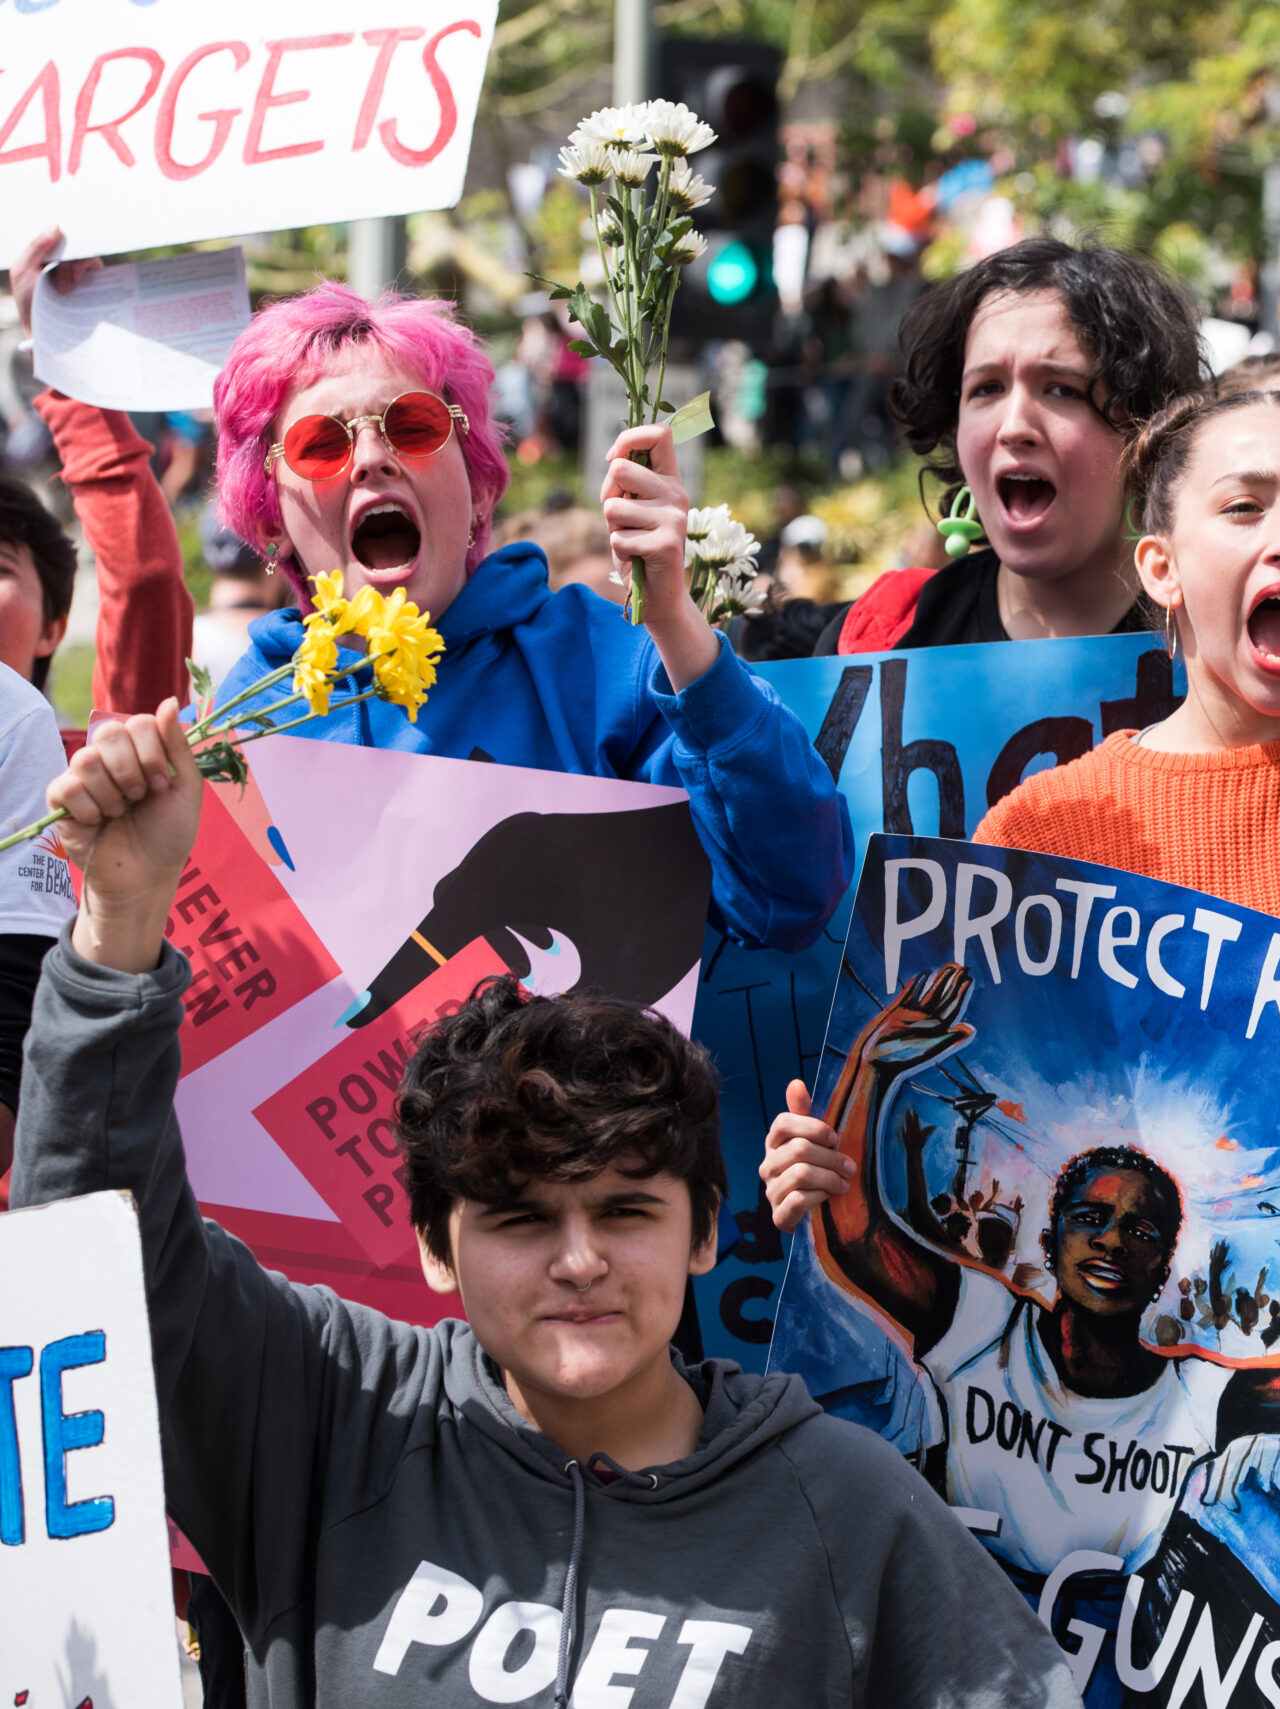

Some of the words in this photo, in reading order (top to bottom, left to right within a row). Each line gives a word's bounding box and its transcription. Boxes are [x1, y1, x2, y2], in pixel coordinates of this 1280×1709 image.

[0, 20, 481, 182] ARGETS
[18, 867, 45, 879] CENTER
[30, 881, 44, 892] FOR
[32, 855, 46, 866] THE
[965, 1386, 1072, 1472] DONT
[1075, 1433, 1195, 1499] SHOOT
[373, 1560, 753, 1709] POET
